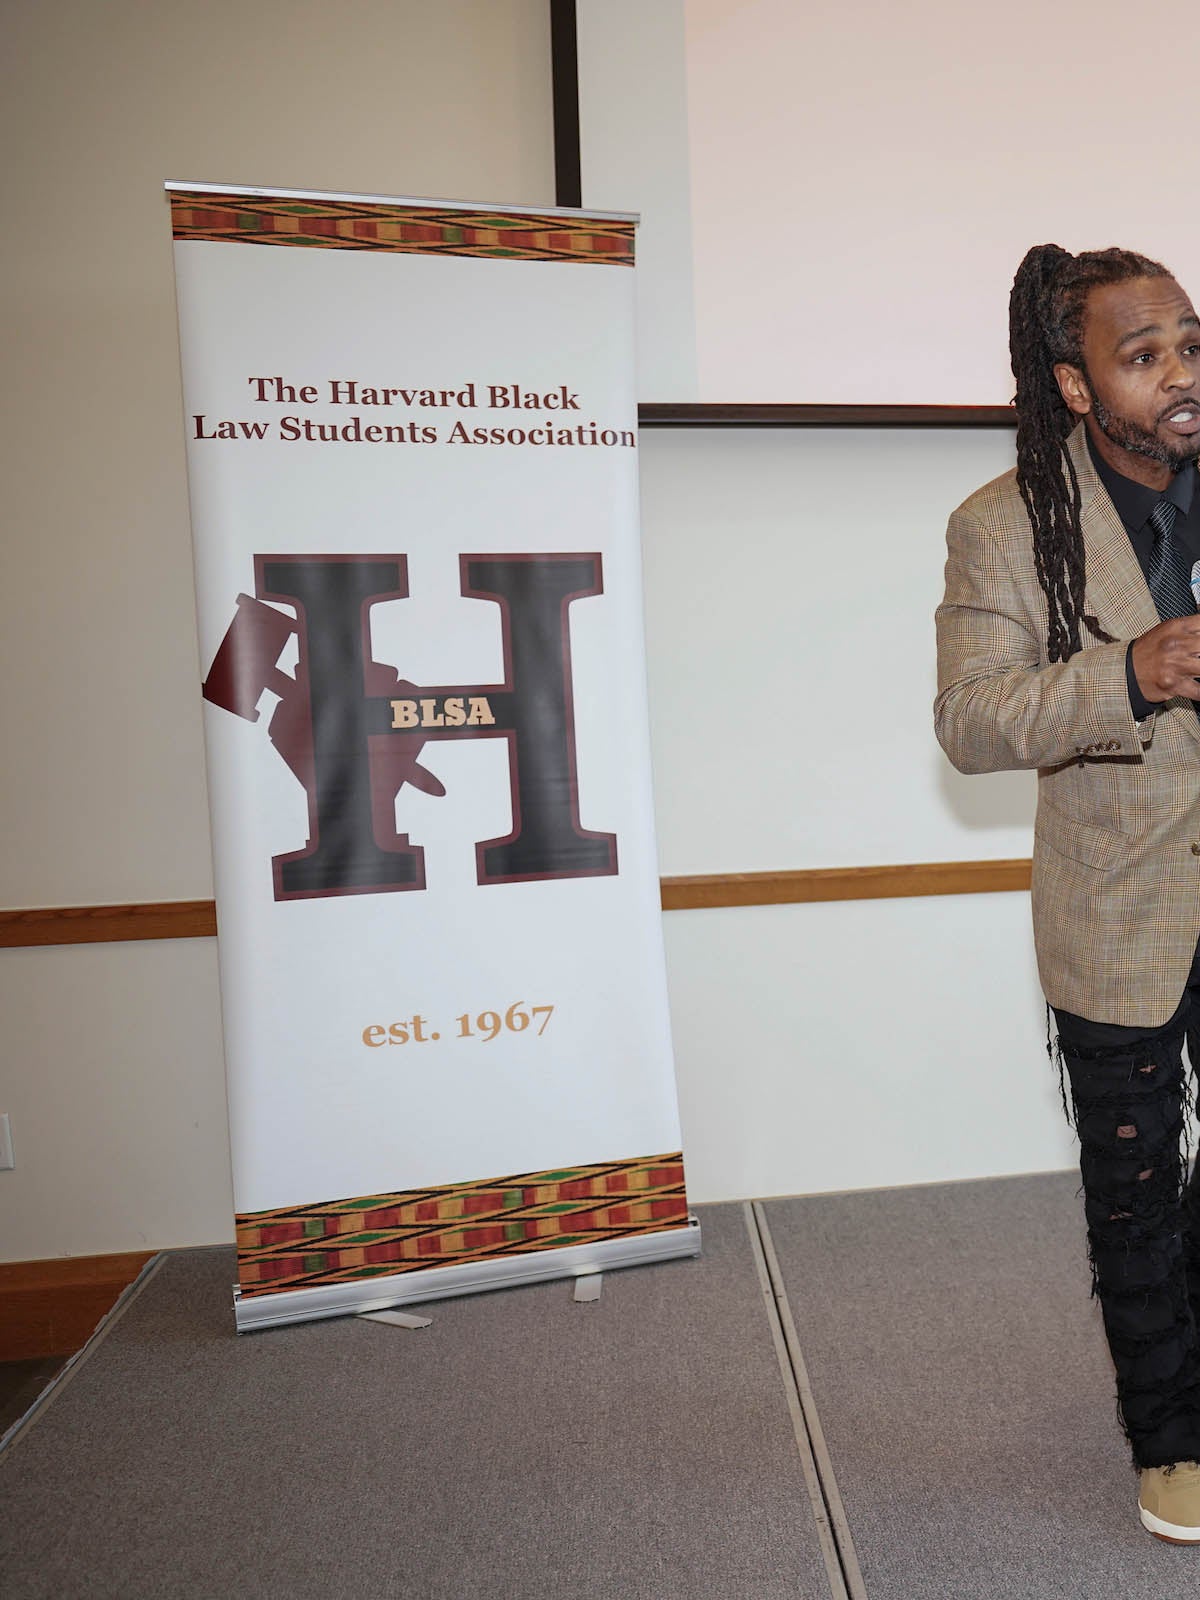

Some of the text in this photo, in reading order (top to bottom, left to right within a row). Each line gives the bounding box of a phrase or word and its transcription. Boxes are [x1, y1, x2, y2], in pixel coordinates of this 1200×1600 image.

[248, 376, 581, 410] The Harvard Black
[191, 414, 636, 448] Law Students Association
[390, 697, 496, 729] BLSA
[362, 1001, 555, 1048] est. 1967
